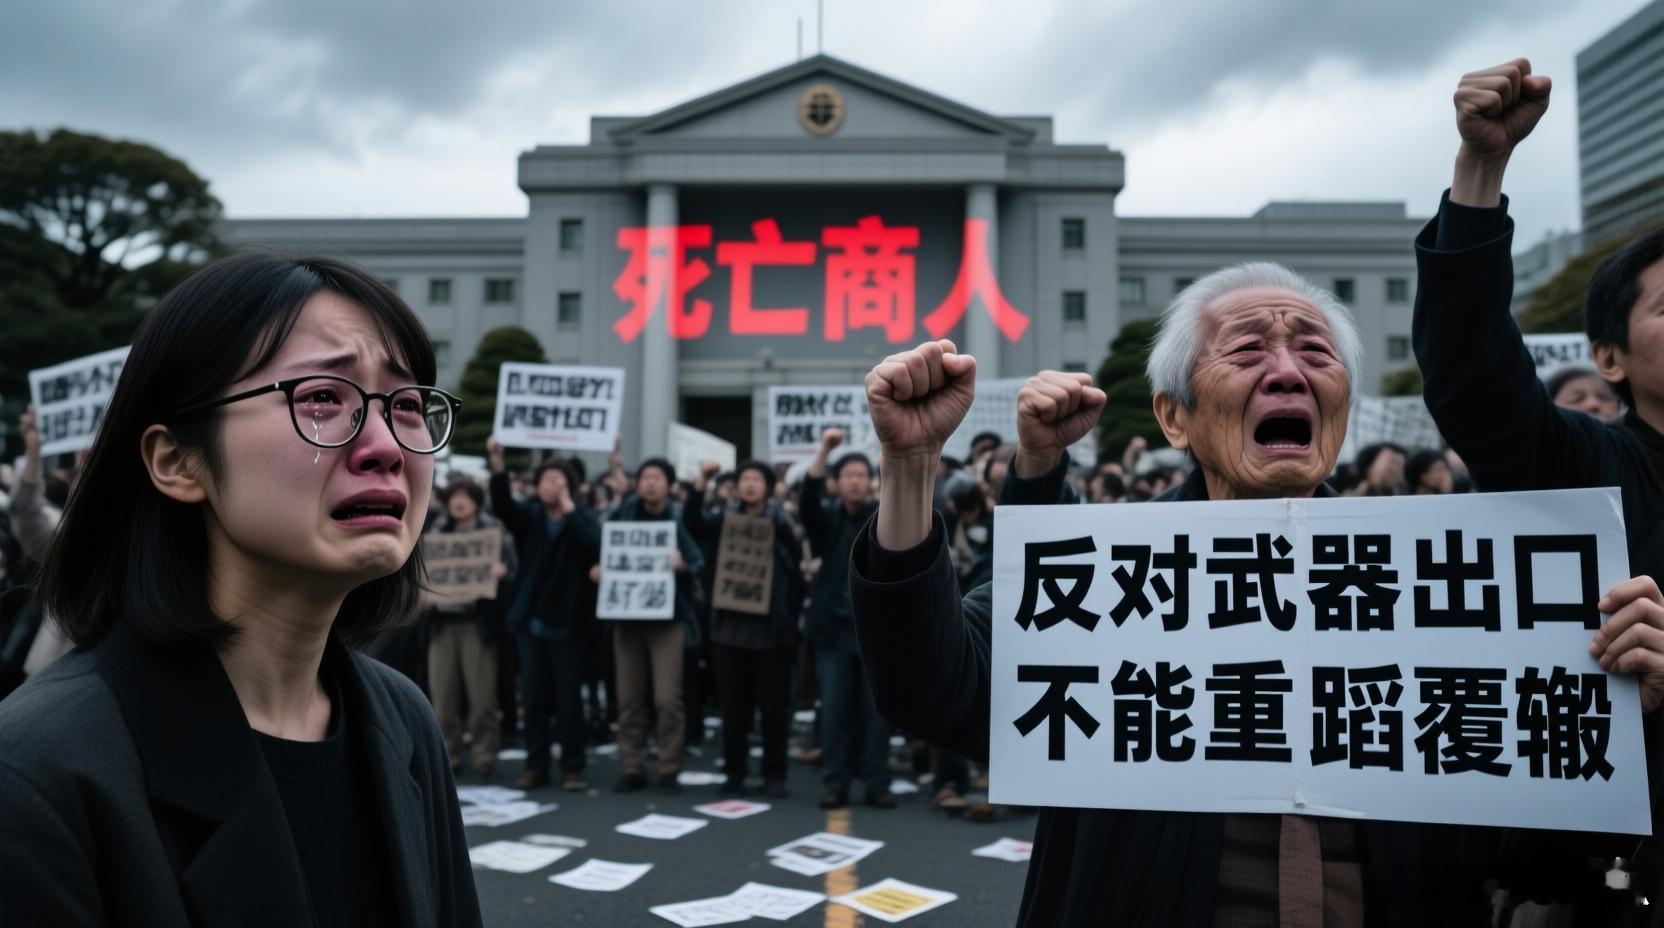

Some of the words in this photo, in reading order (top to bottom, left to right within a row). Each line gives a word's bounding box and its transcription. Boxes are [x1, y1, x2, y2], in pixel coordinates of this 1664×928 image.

[613, 216, 1029, 342] 死亡商人
[1014, 529, 1601, 632] 反对武器出口
